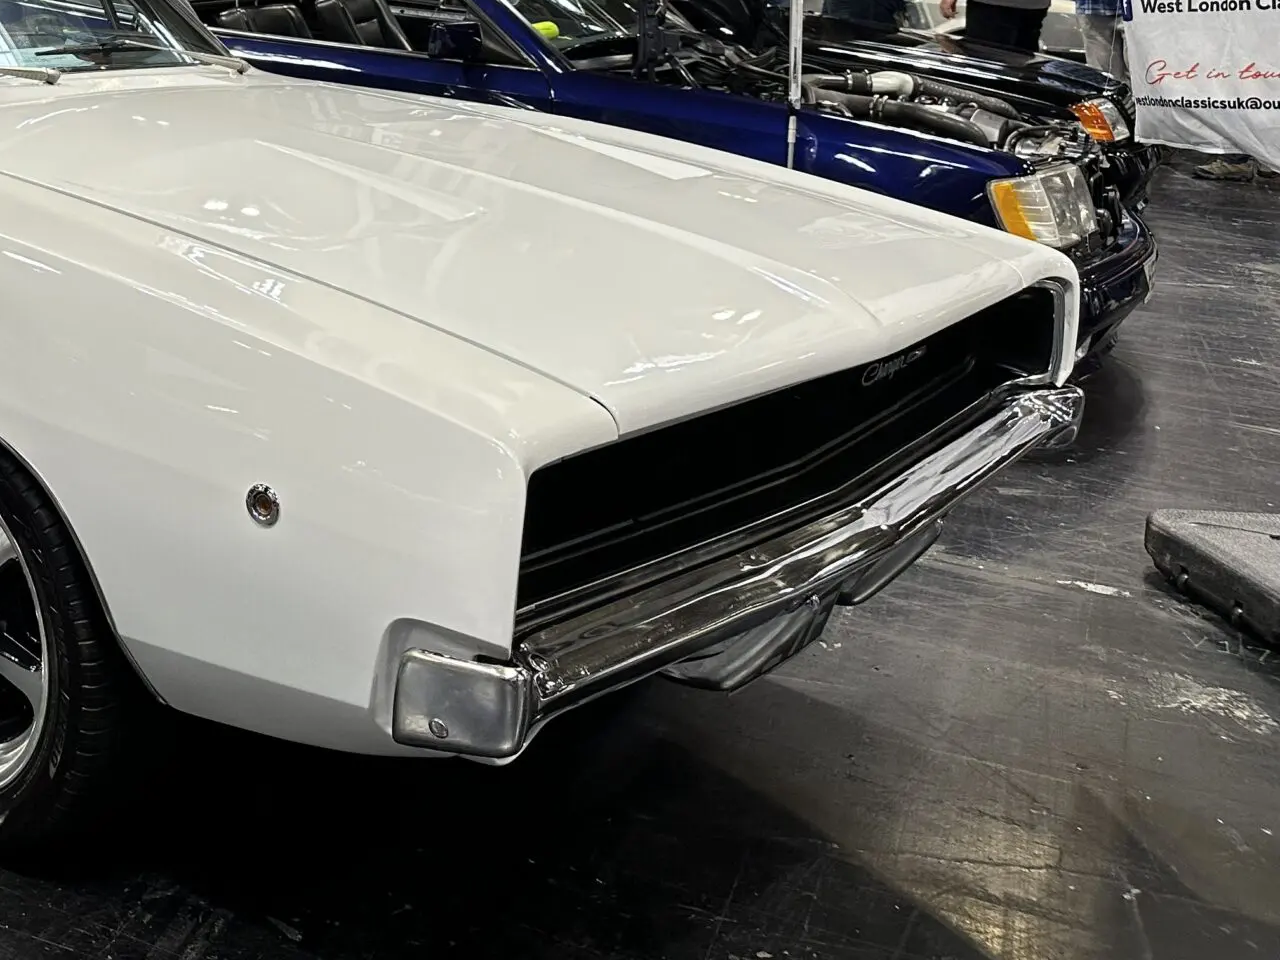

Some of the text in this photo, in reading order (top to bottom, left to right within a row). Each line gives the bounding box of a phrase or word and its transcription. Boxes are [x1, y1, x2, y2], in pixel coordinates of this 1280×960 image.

[1140, 0, 1184, 14] West
[1145, 60, 1280, 85] Get in tou
